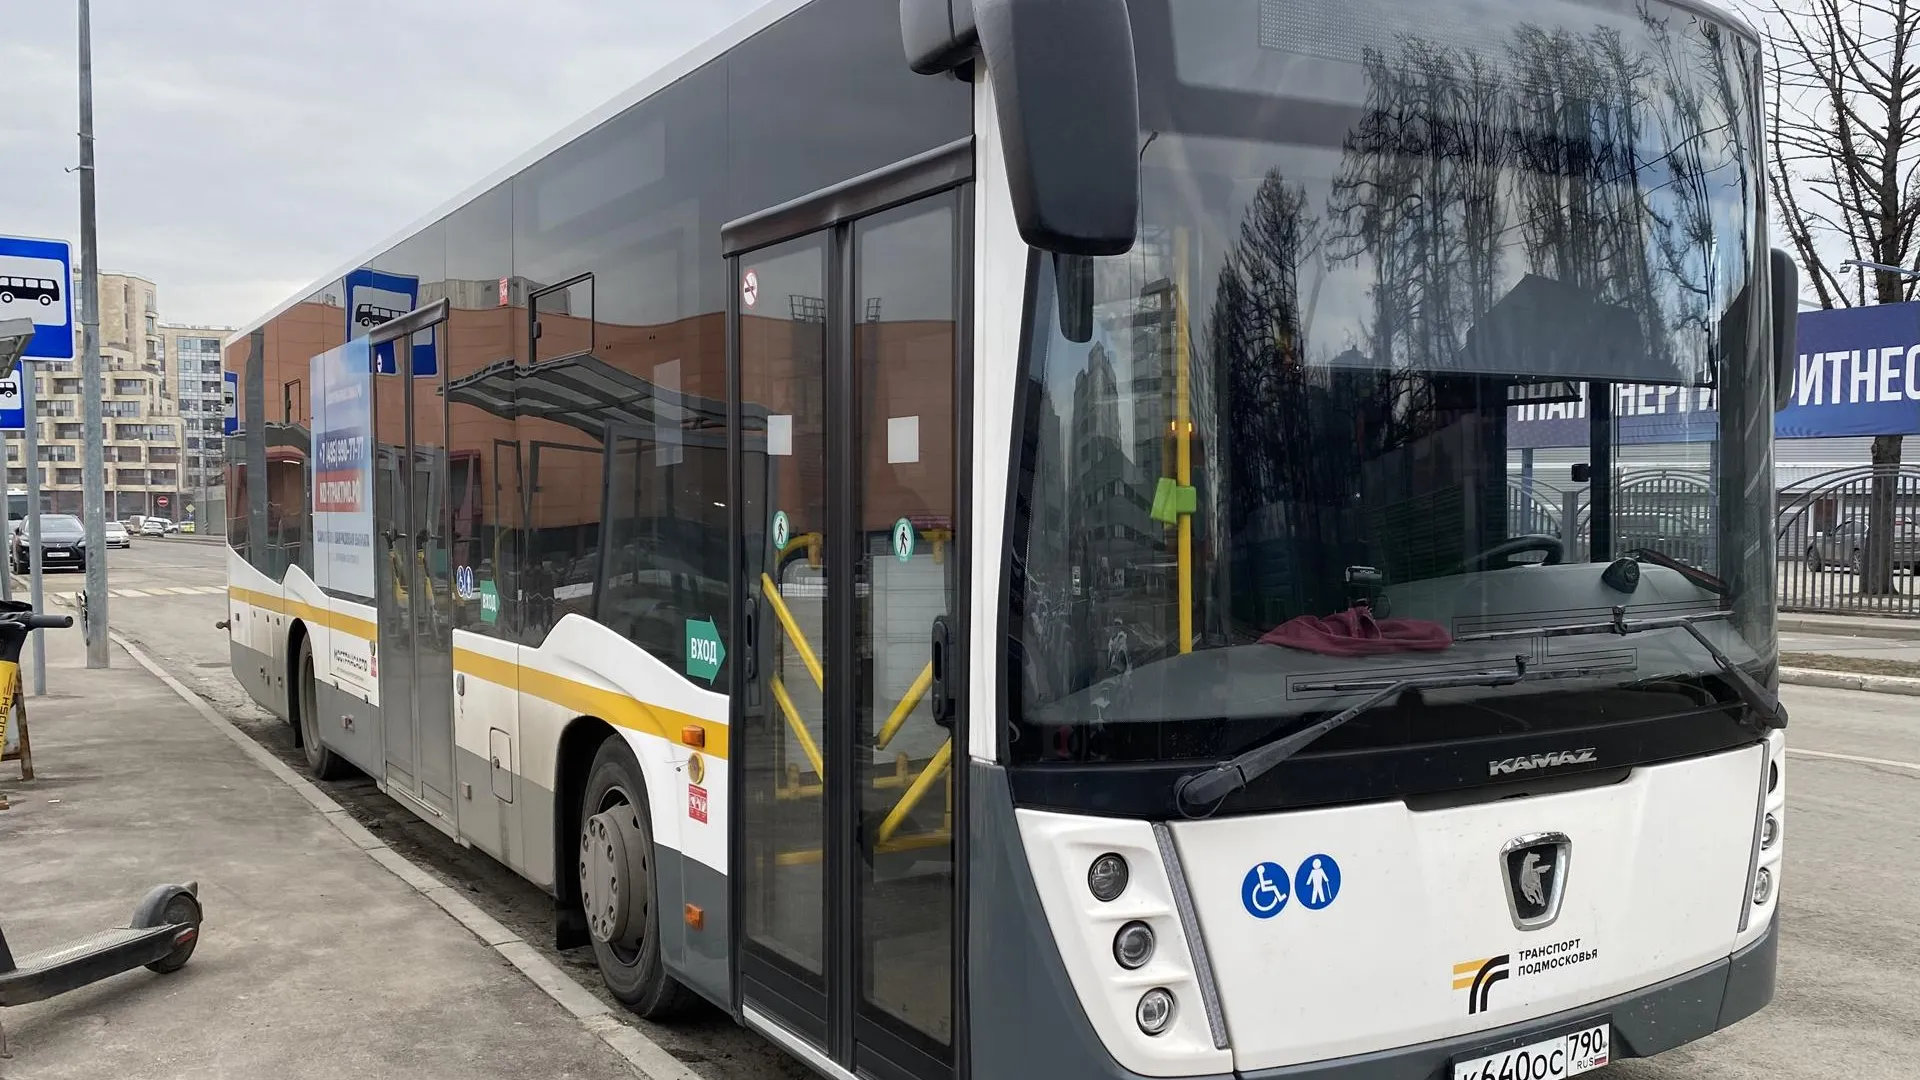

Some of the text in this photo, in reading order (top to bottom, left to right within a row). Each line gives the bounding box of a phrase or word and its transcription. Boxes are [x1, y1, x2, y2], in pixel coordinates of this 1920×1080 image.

[1790, 344, 1920, 406] ИТНЕС
[481, 594, 497, 612] ВХОД
[690, 637, 717, 666] ВХОД
[1488, 747, 1598, 776] KAMAZ
[1518, 938, 1581, 961] ТРАНСПОРТ
[1518, 948, 1598, 976] ПОДМОСКОВЬЯ
[1569, 1028, 1603, 1061] 790
[1576, 1057, 1594, 1070] RUS
